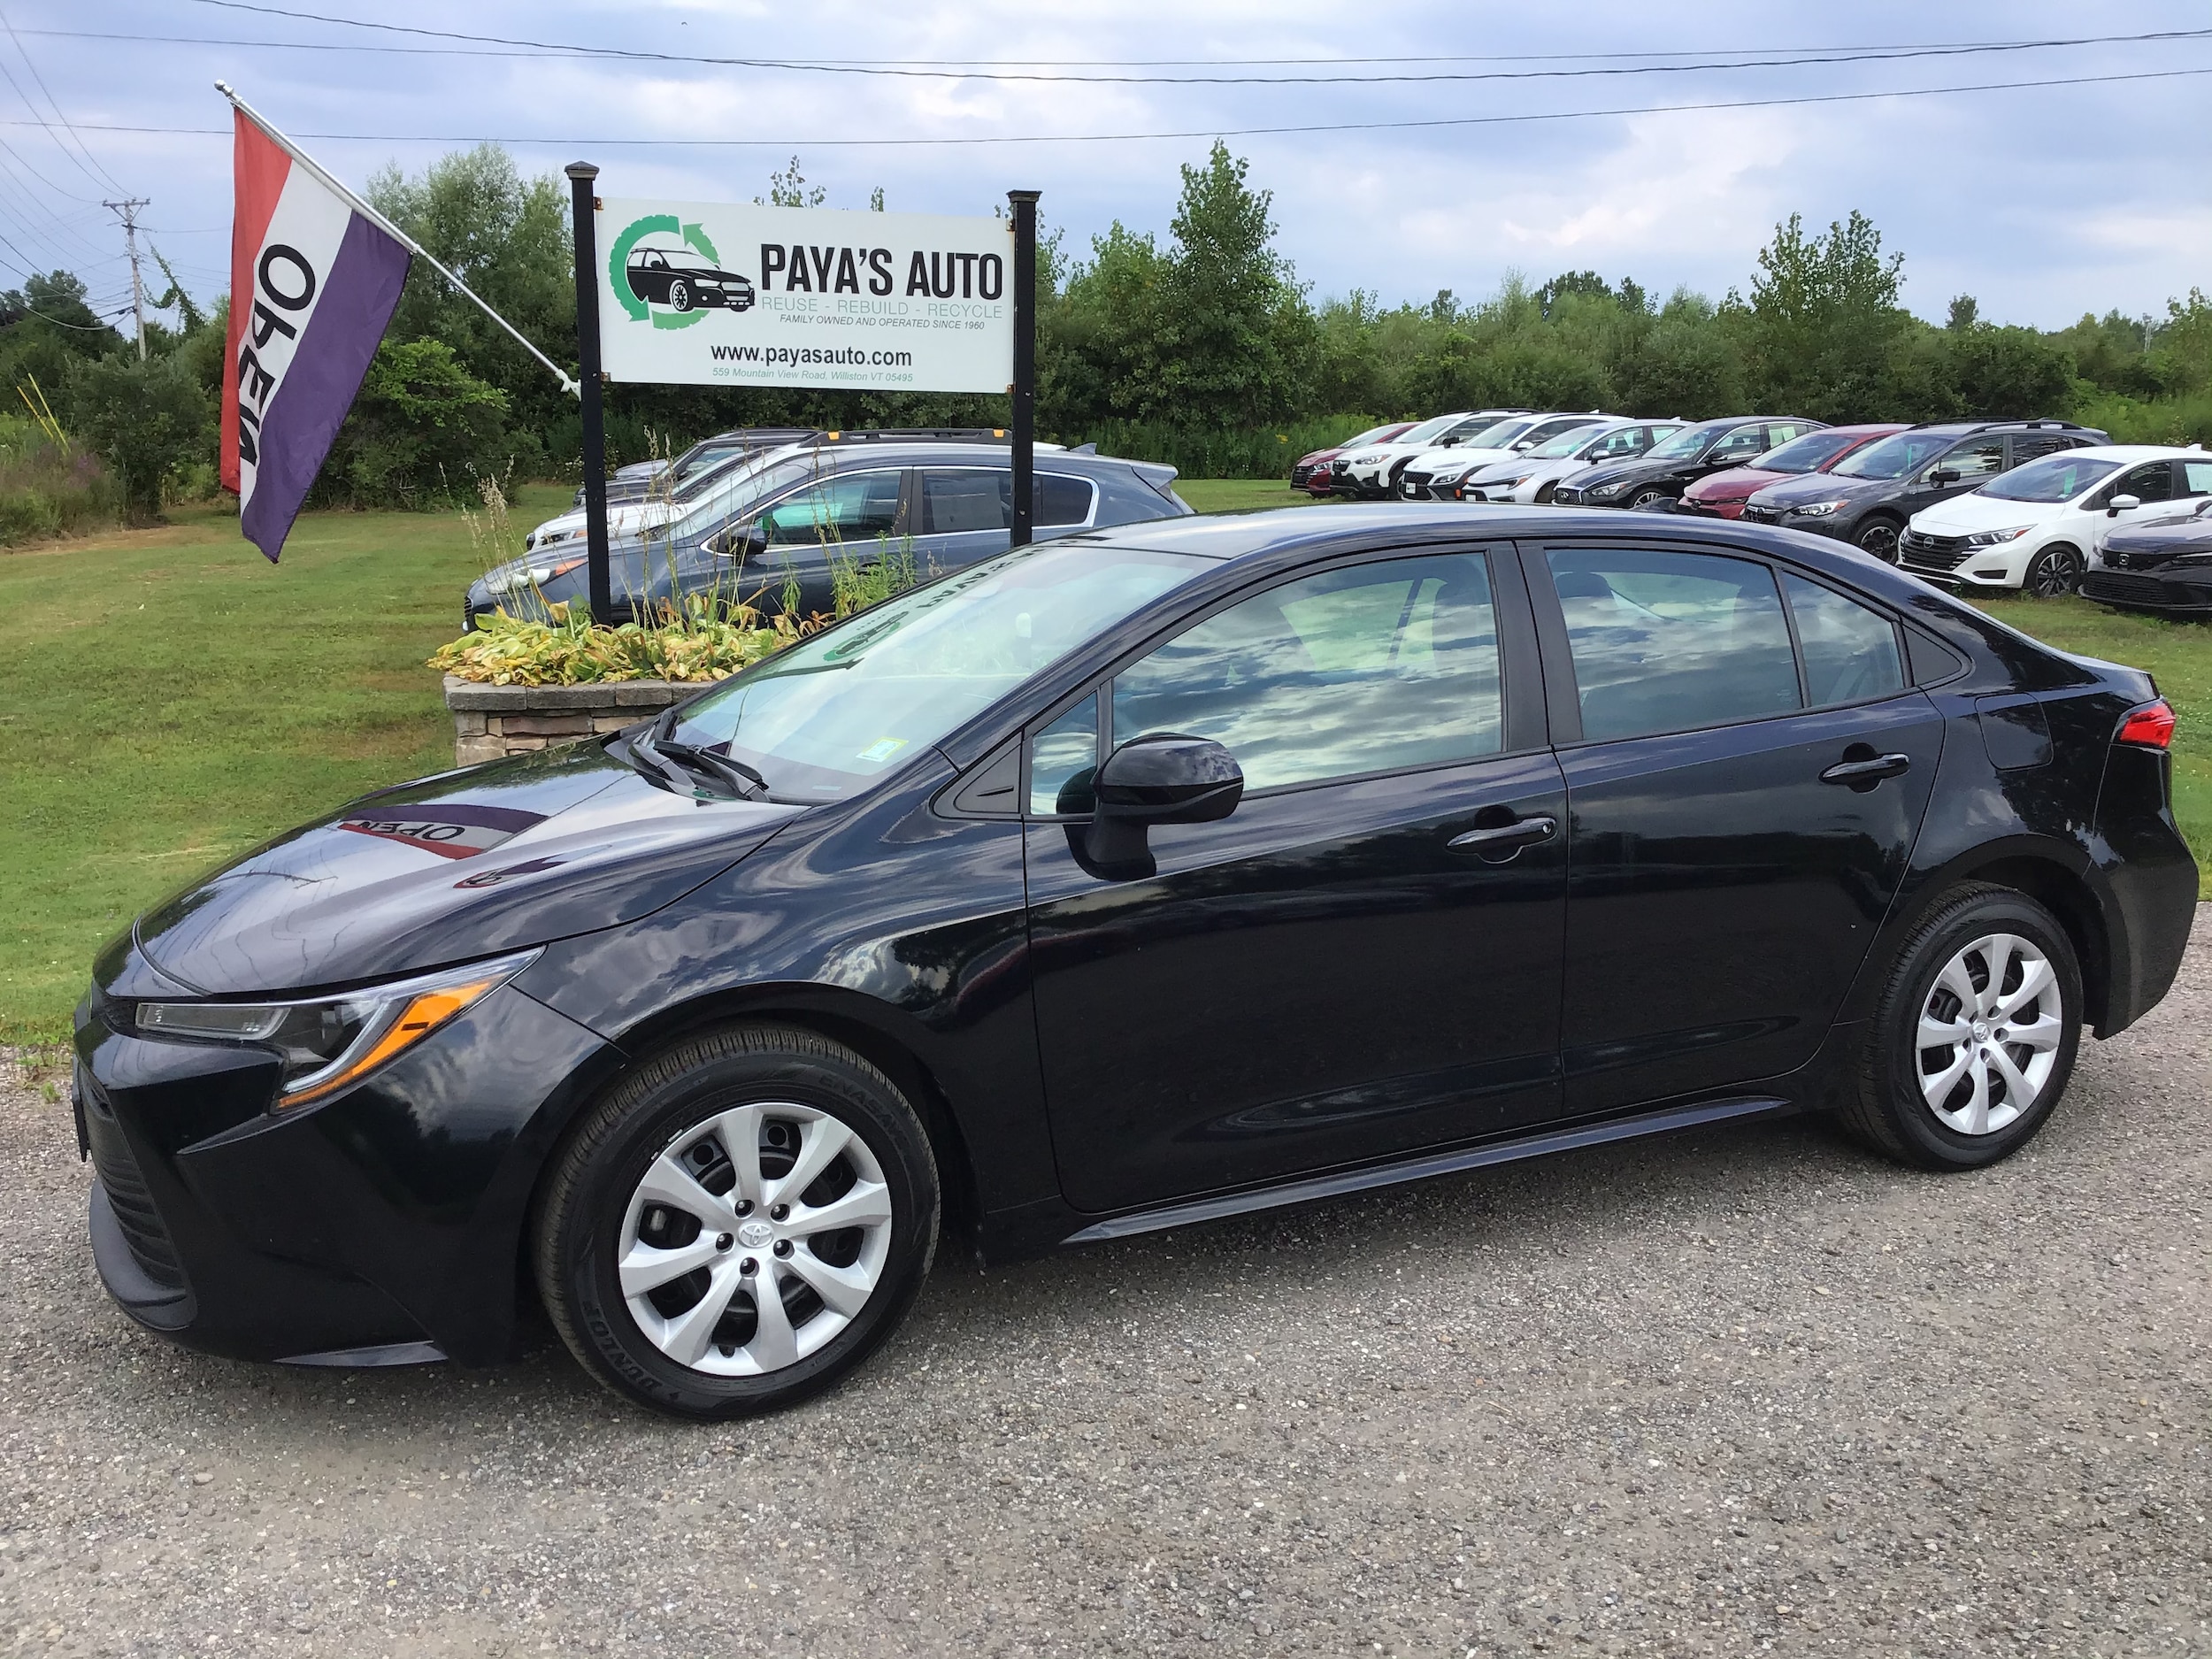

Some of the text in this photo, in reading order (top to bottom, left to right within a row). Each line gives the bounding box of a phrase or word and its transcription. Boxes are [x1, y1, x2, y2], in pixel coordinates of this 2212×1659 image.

[761, 243, 1002, 301] PAYA'S AUTO
[762, 296, 818, 311] REUSE
[837, 299, 909, 315] REBUILD
[927, 303, 1002, 319] RECYCLE
[780, 314, 985, 330] FAMILY OWNED AND OPERATED SINCE 1960
[710, 345, 911, 367] www.payasauto.com
[712, 367, 913, 382] 559 Mountain View Road, Williston VT 05495
[357, 820, 465, 841] OPEN
